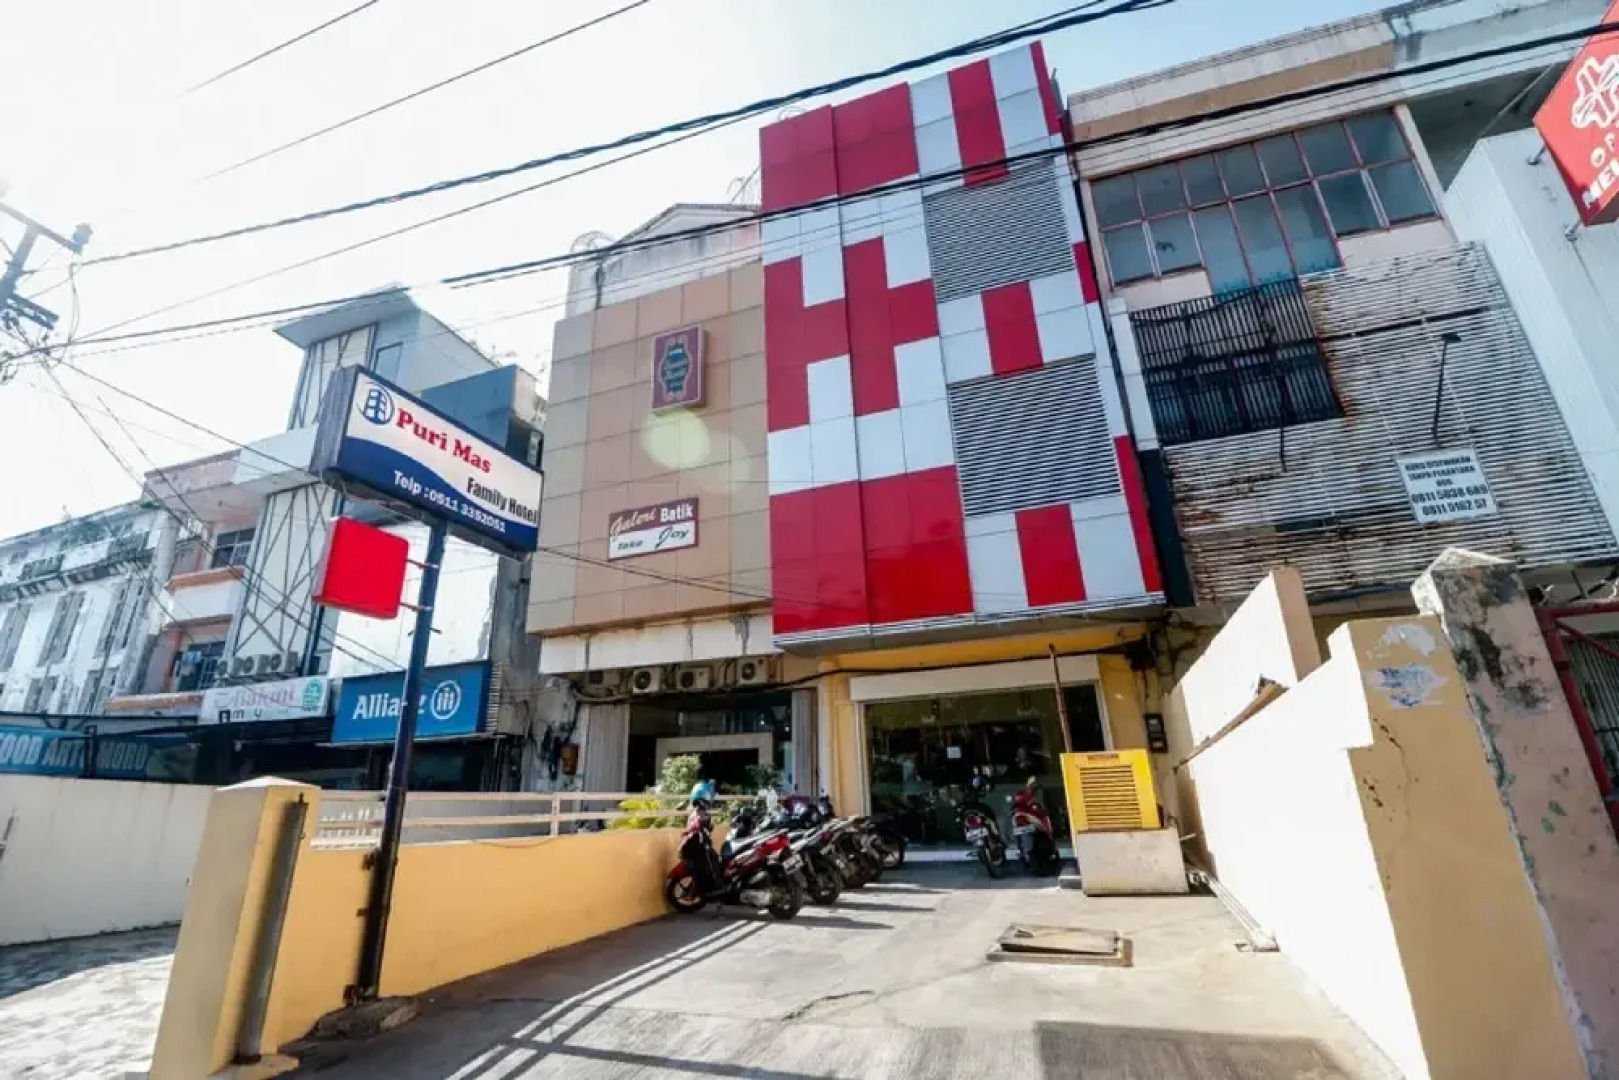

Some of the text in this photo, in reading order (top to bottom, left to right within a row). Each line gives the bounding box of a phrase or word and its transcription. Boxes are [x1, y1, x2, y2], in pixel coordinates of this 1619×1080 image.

[396, 408, 492, 474] Puri Mas
[394, 469, 422, 496] Telp
[467, 476, 540, 525] Family Hotel
[661, 503, 694, 523] Batik
[352, 692, 428, 720] Alliaz
